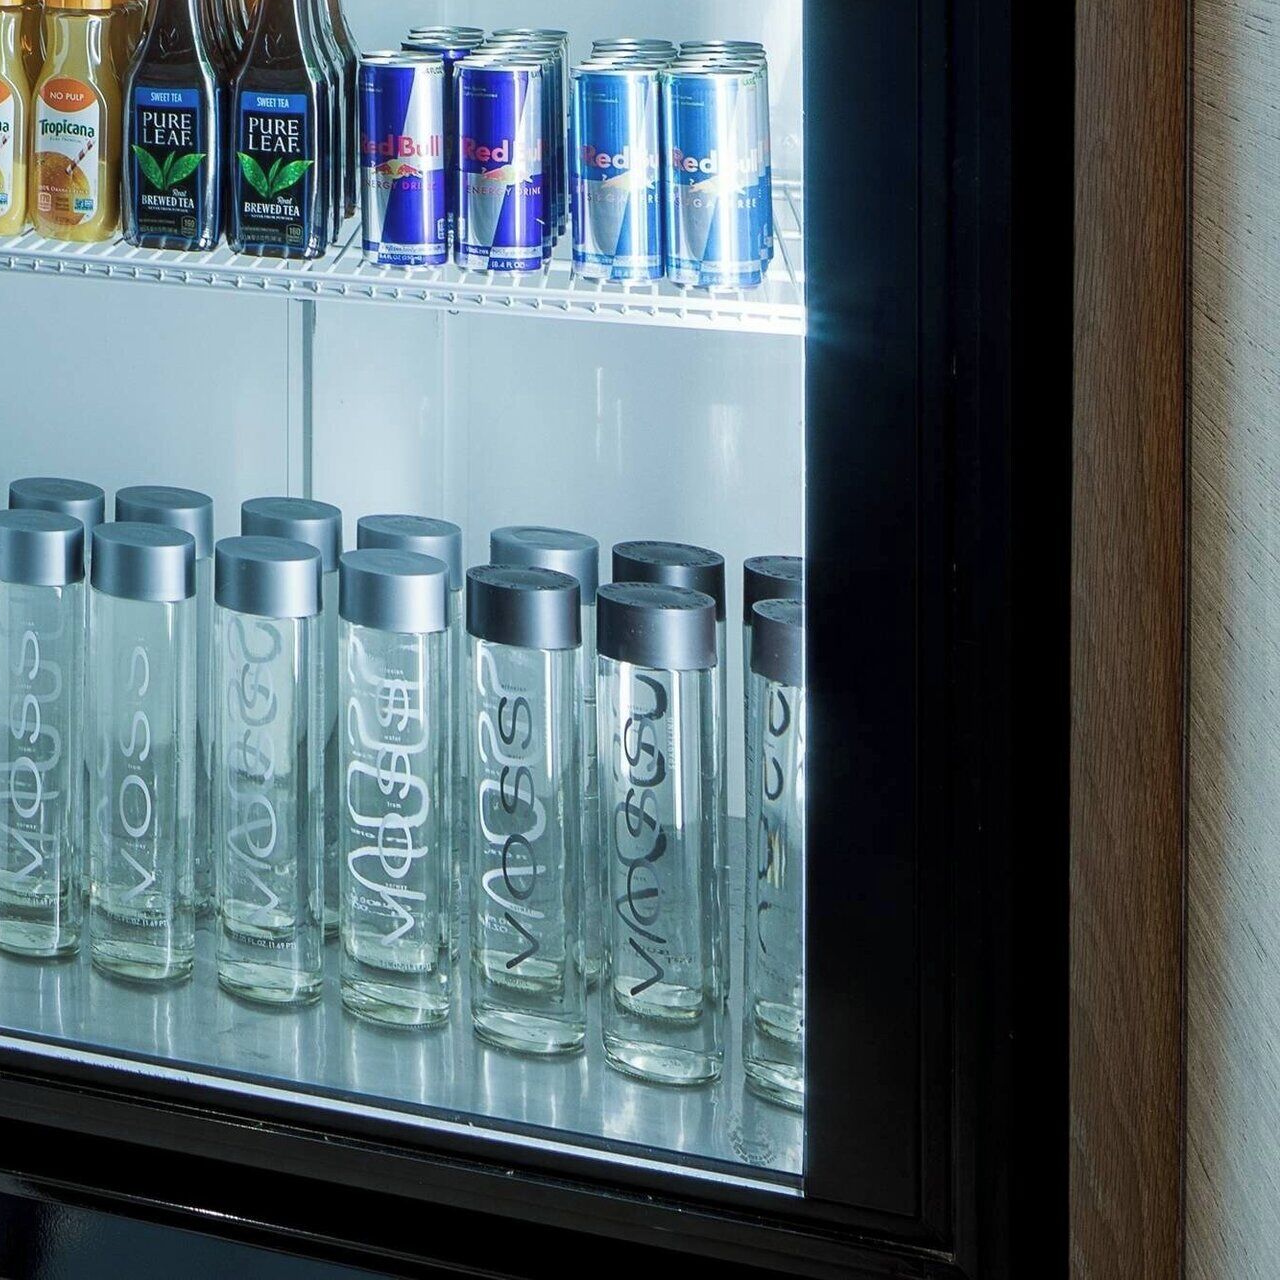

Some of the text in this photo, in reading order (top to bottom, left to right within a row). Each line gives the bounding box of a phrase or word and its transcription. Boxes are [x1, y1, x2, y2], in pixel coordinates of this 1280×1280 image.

[50, 91, 85, 101] NO PULP
[151, 92, 183, 102] SWEET TEA
[256, 97, 290, 108] SWEET TEA
[39, 118, 95, 138] Tropicana
[143, 111, 192, 130] PURE
[248, 117, 299, 136] PURE
[143, 128, 192, 146] LEAF
[248, 134, 300, 153] LEAF
[398, 135, 439, 157] Bull
[461, 135, 509, 163] Red
[582, 144, 629, 170] Red
[672, 147, 716, 174] Red
[172, 188, 187, 197] Real
[276, 196, 293, 205] Real
[466, 186, 512, 196] ENERGY
[141, 194, 177, 207] BREWED
[179, 197, 195, 209] TEA
[244, 202, 282, 214] BREWED
[283, 205, 301, 217] TEA
[10, 630, 43, 881] VOSS
[119, 646, 155, 903] VOSS
[498, 696, 540, 969] VOSS
